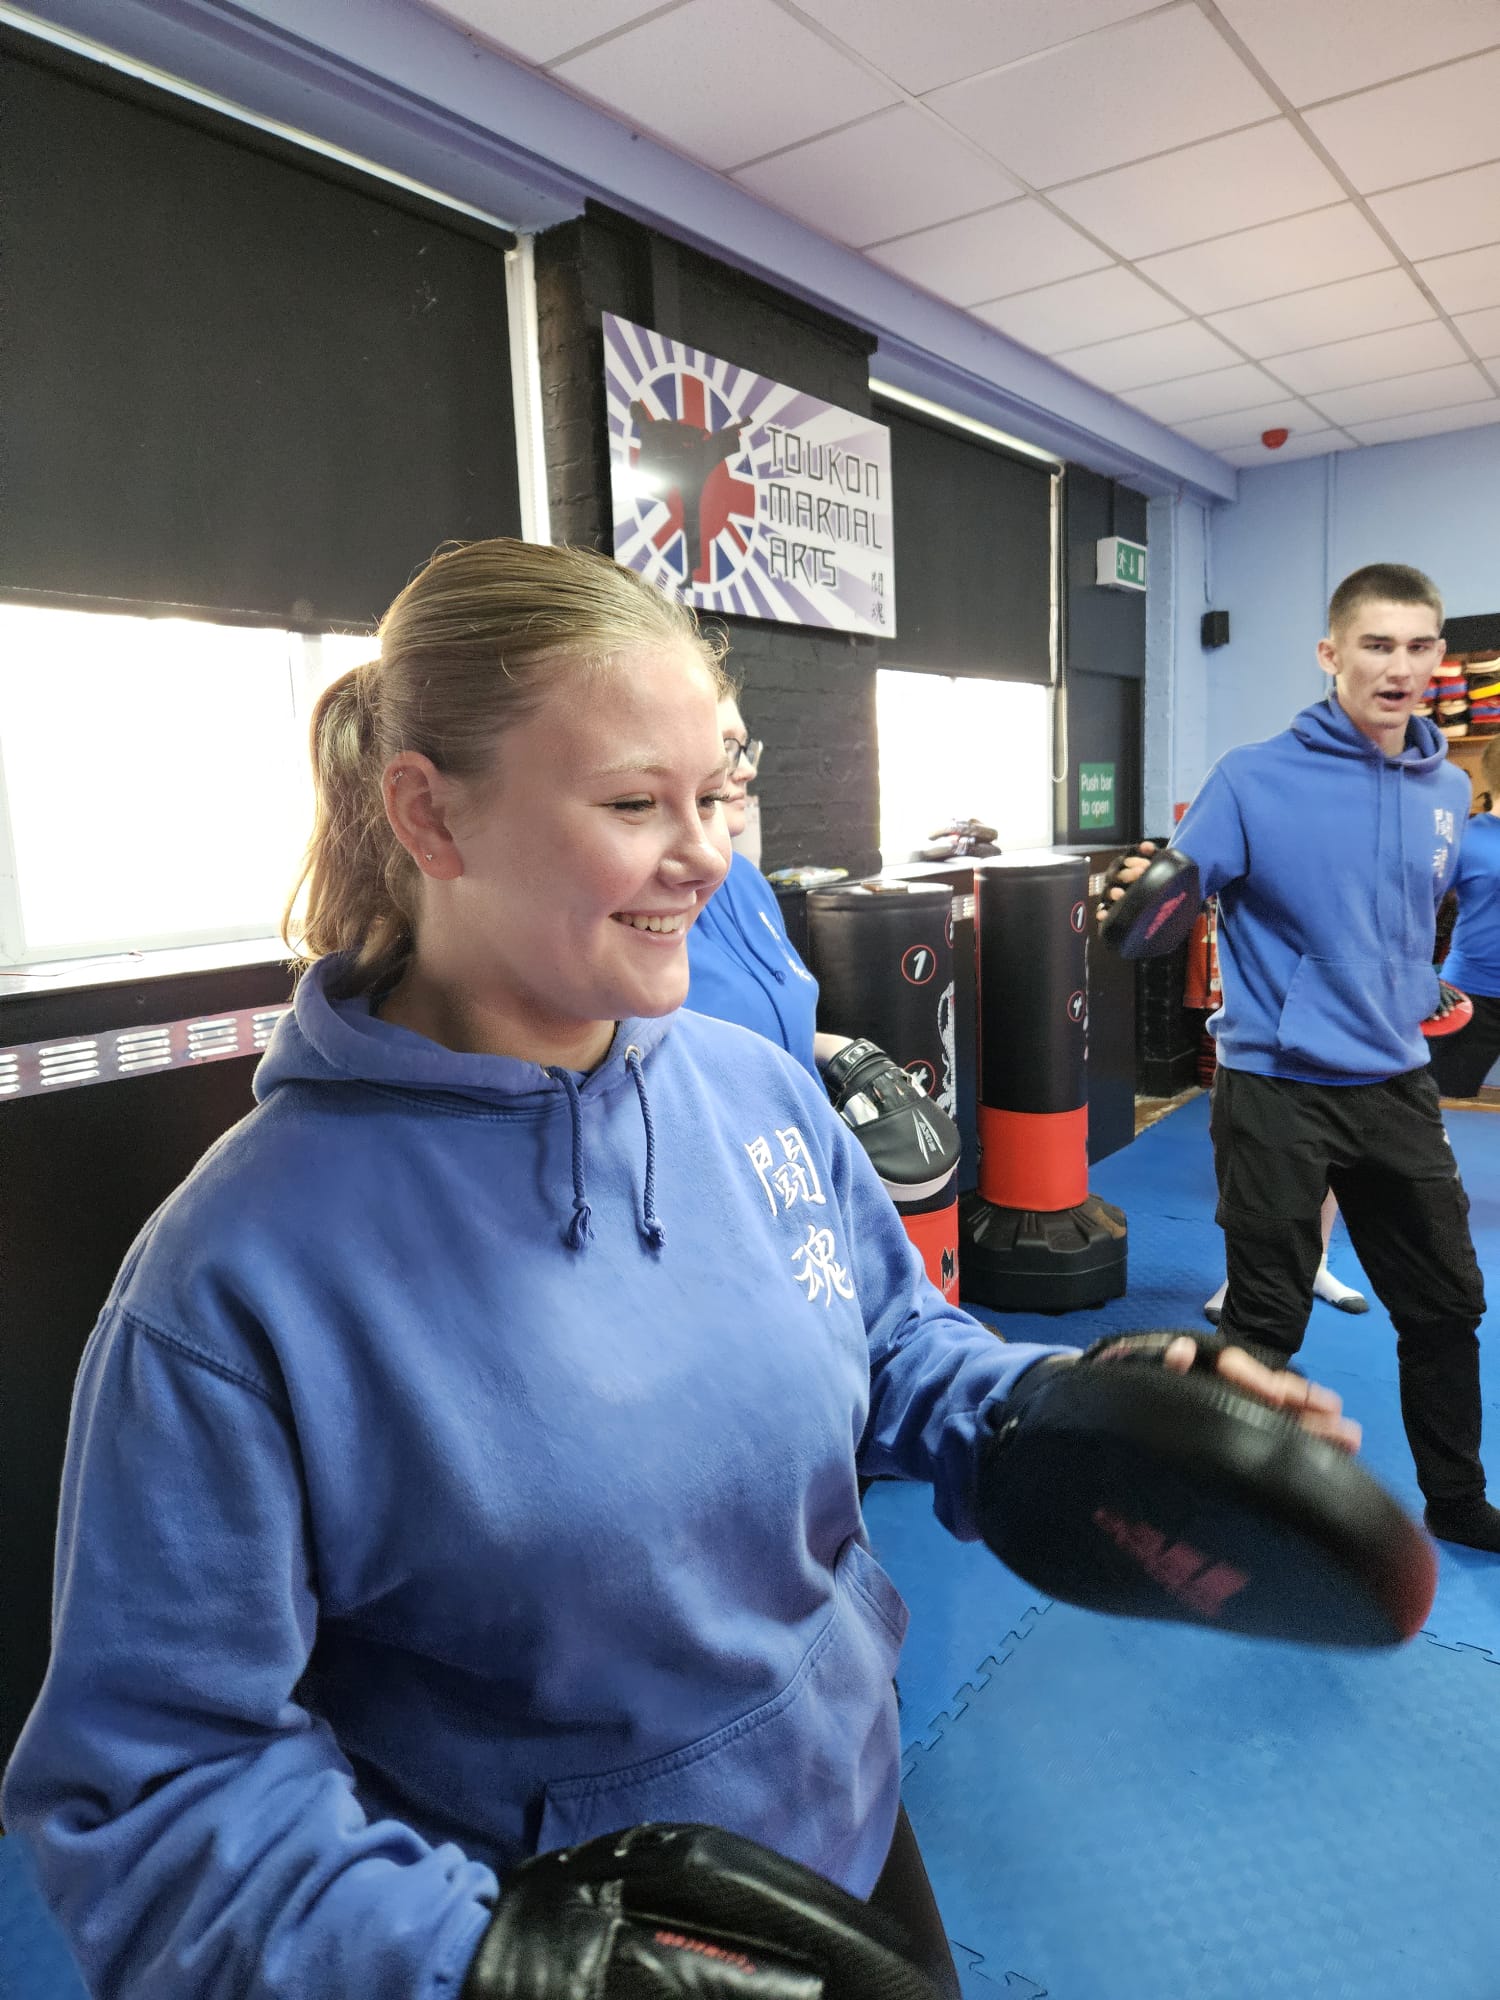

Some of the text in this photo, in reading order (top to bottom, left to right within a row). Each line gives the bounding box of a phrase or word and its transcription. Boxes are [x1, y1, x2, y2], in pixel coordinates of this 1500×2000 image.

[766, 426, 880, 500] TOUKON
[769, 482, 883, 549] MARTIAL
[769, 536, 837, 588] ARTS
[1081, 773, 1112, 792] Push bar
[1081, 800, 1109, 818] to open
[1077, 906, 1084, 929] 1
[913, 950, 927, 980] 1
